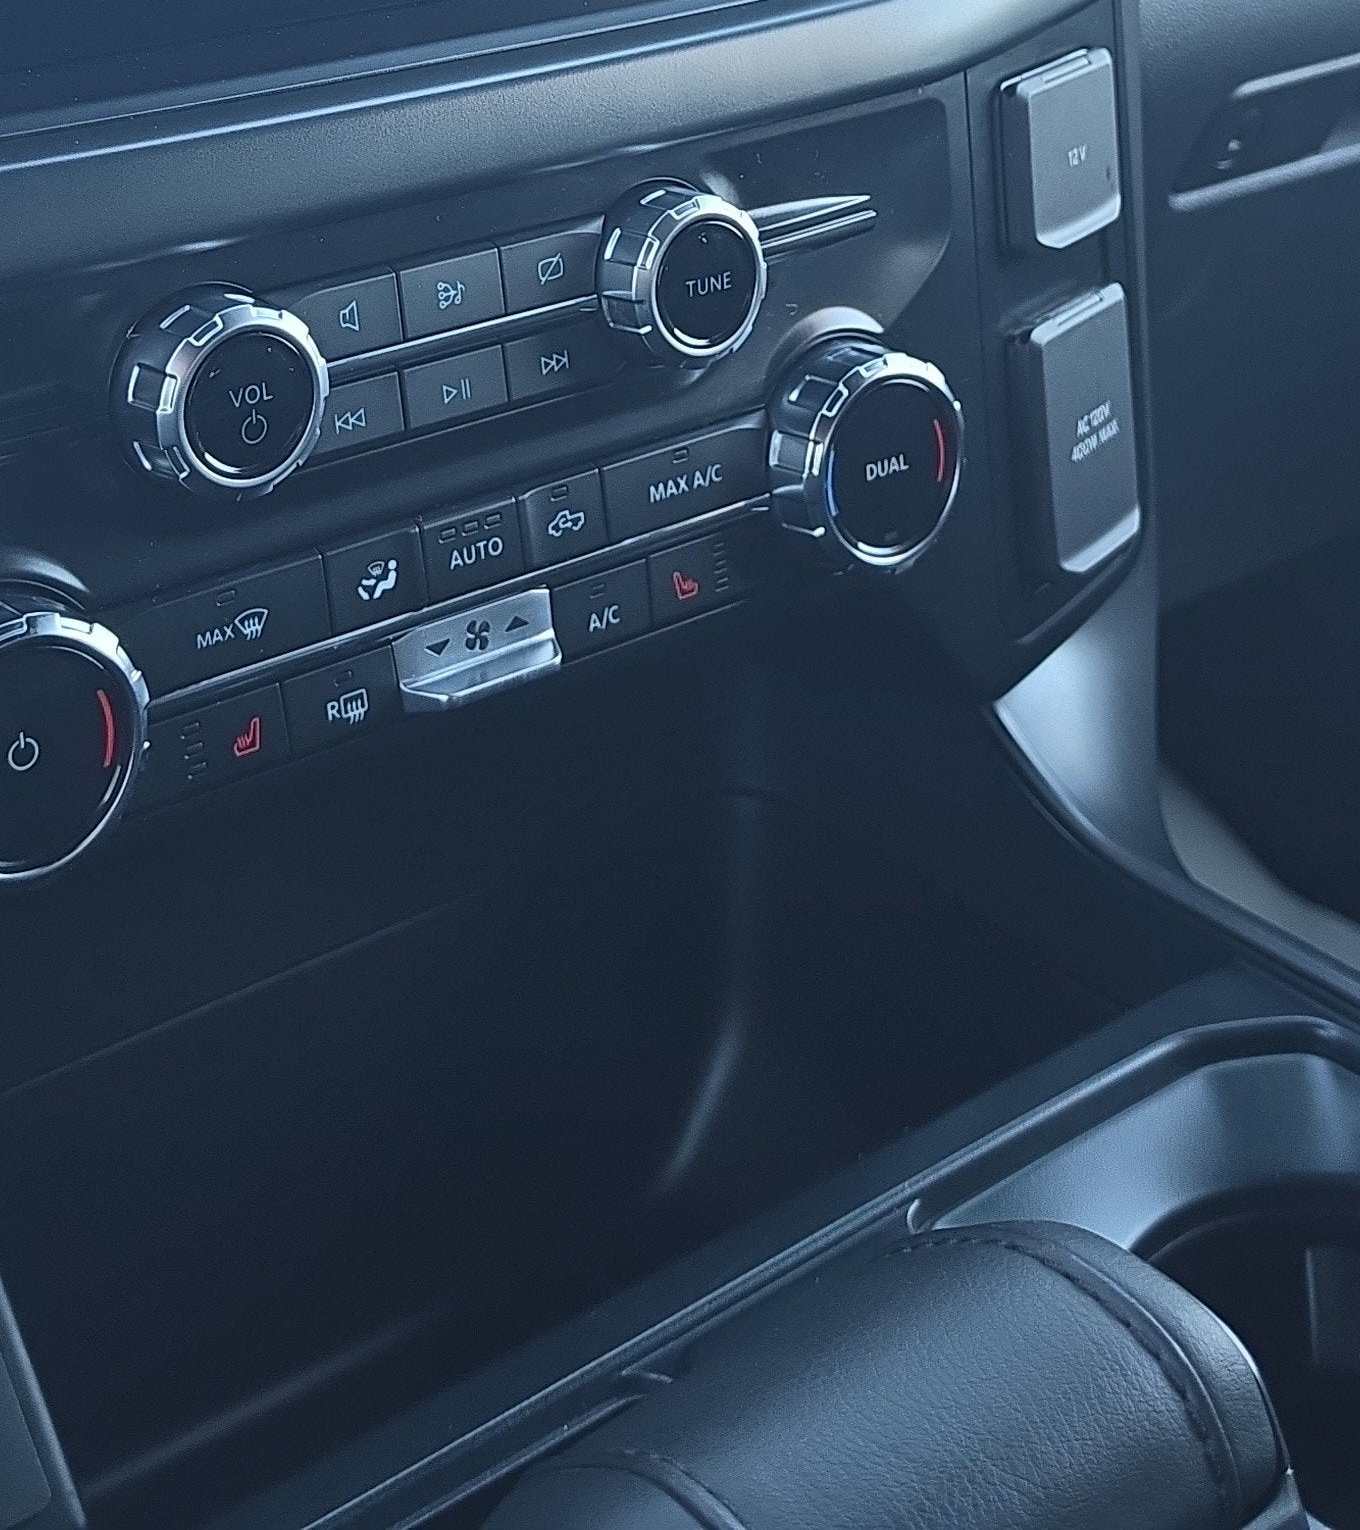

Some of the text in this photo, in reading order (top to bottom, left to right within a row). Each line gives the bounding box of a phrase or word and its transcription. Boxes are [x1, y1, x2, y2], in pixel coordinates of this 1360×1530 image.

[1067, 143, 1087, 168] 12V
[684, 270, 732, 297] TUNE
[228, 385, 274, 408] VOL
[865, 455, 909, 481] DUAL
[649, 463, 724, 504] MAX A/C
[449, 536, 505, 570] AUTO
[588, 604, 621, 632] A/C
[195, 626, 236, 650] MAX
[327, 700, 340, 723] R
